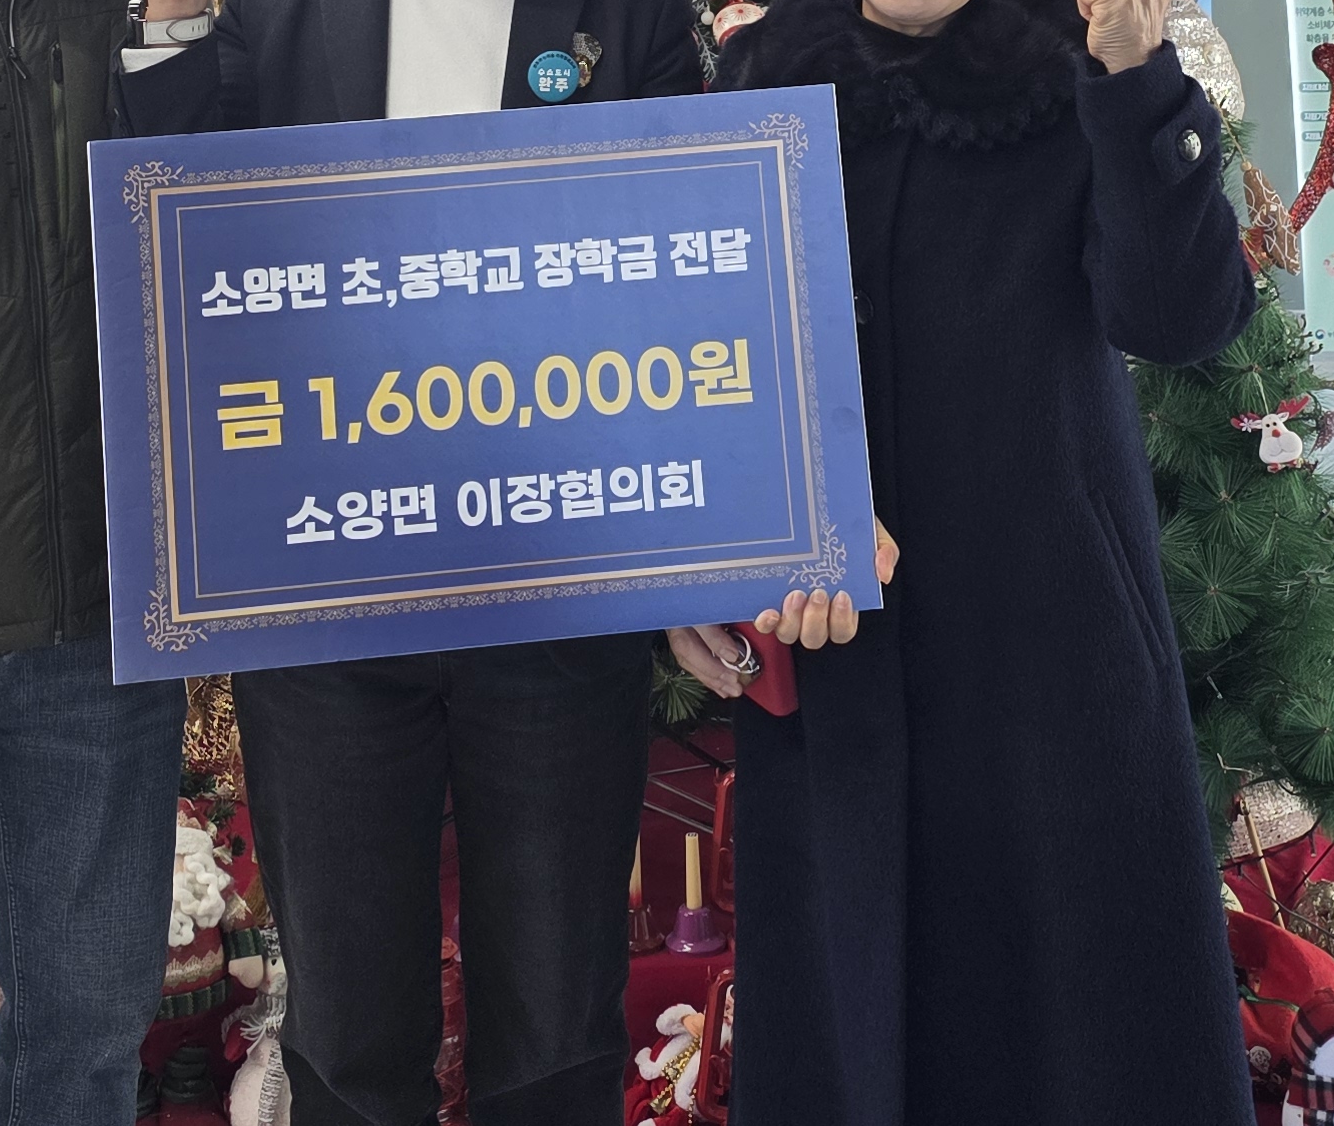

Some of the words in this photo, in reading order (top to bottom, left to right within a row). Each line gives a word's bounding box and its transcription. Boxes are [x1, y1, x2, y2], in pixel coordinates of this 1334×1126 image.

[539, 76, 569, 92] 완주
[201, 262, 327, 318] 소양면
[341, 247, 525, 308] 초,중학교
[533, 234, 657, 290] 장학금
[669, 227, 751, 278] 전달
[216, 380, 285, 451] 금
[308, 338, 754, 444] 1,600,000원
[286, 484, 439, 546] 소양면
[457, 459, 706, 527] 이장협의회
